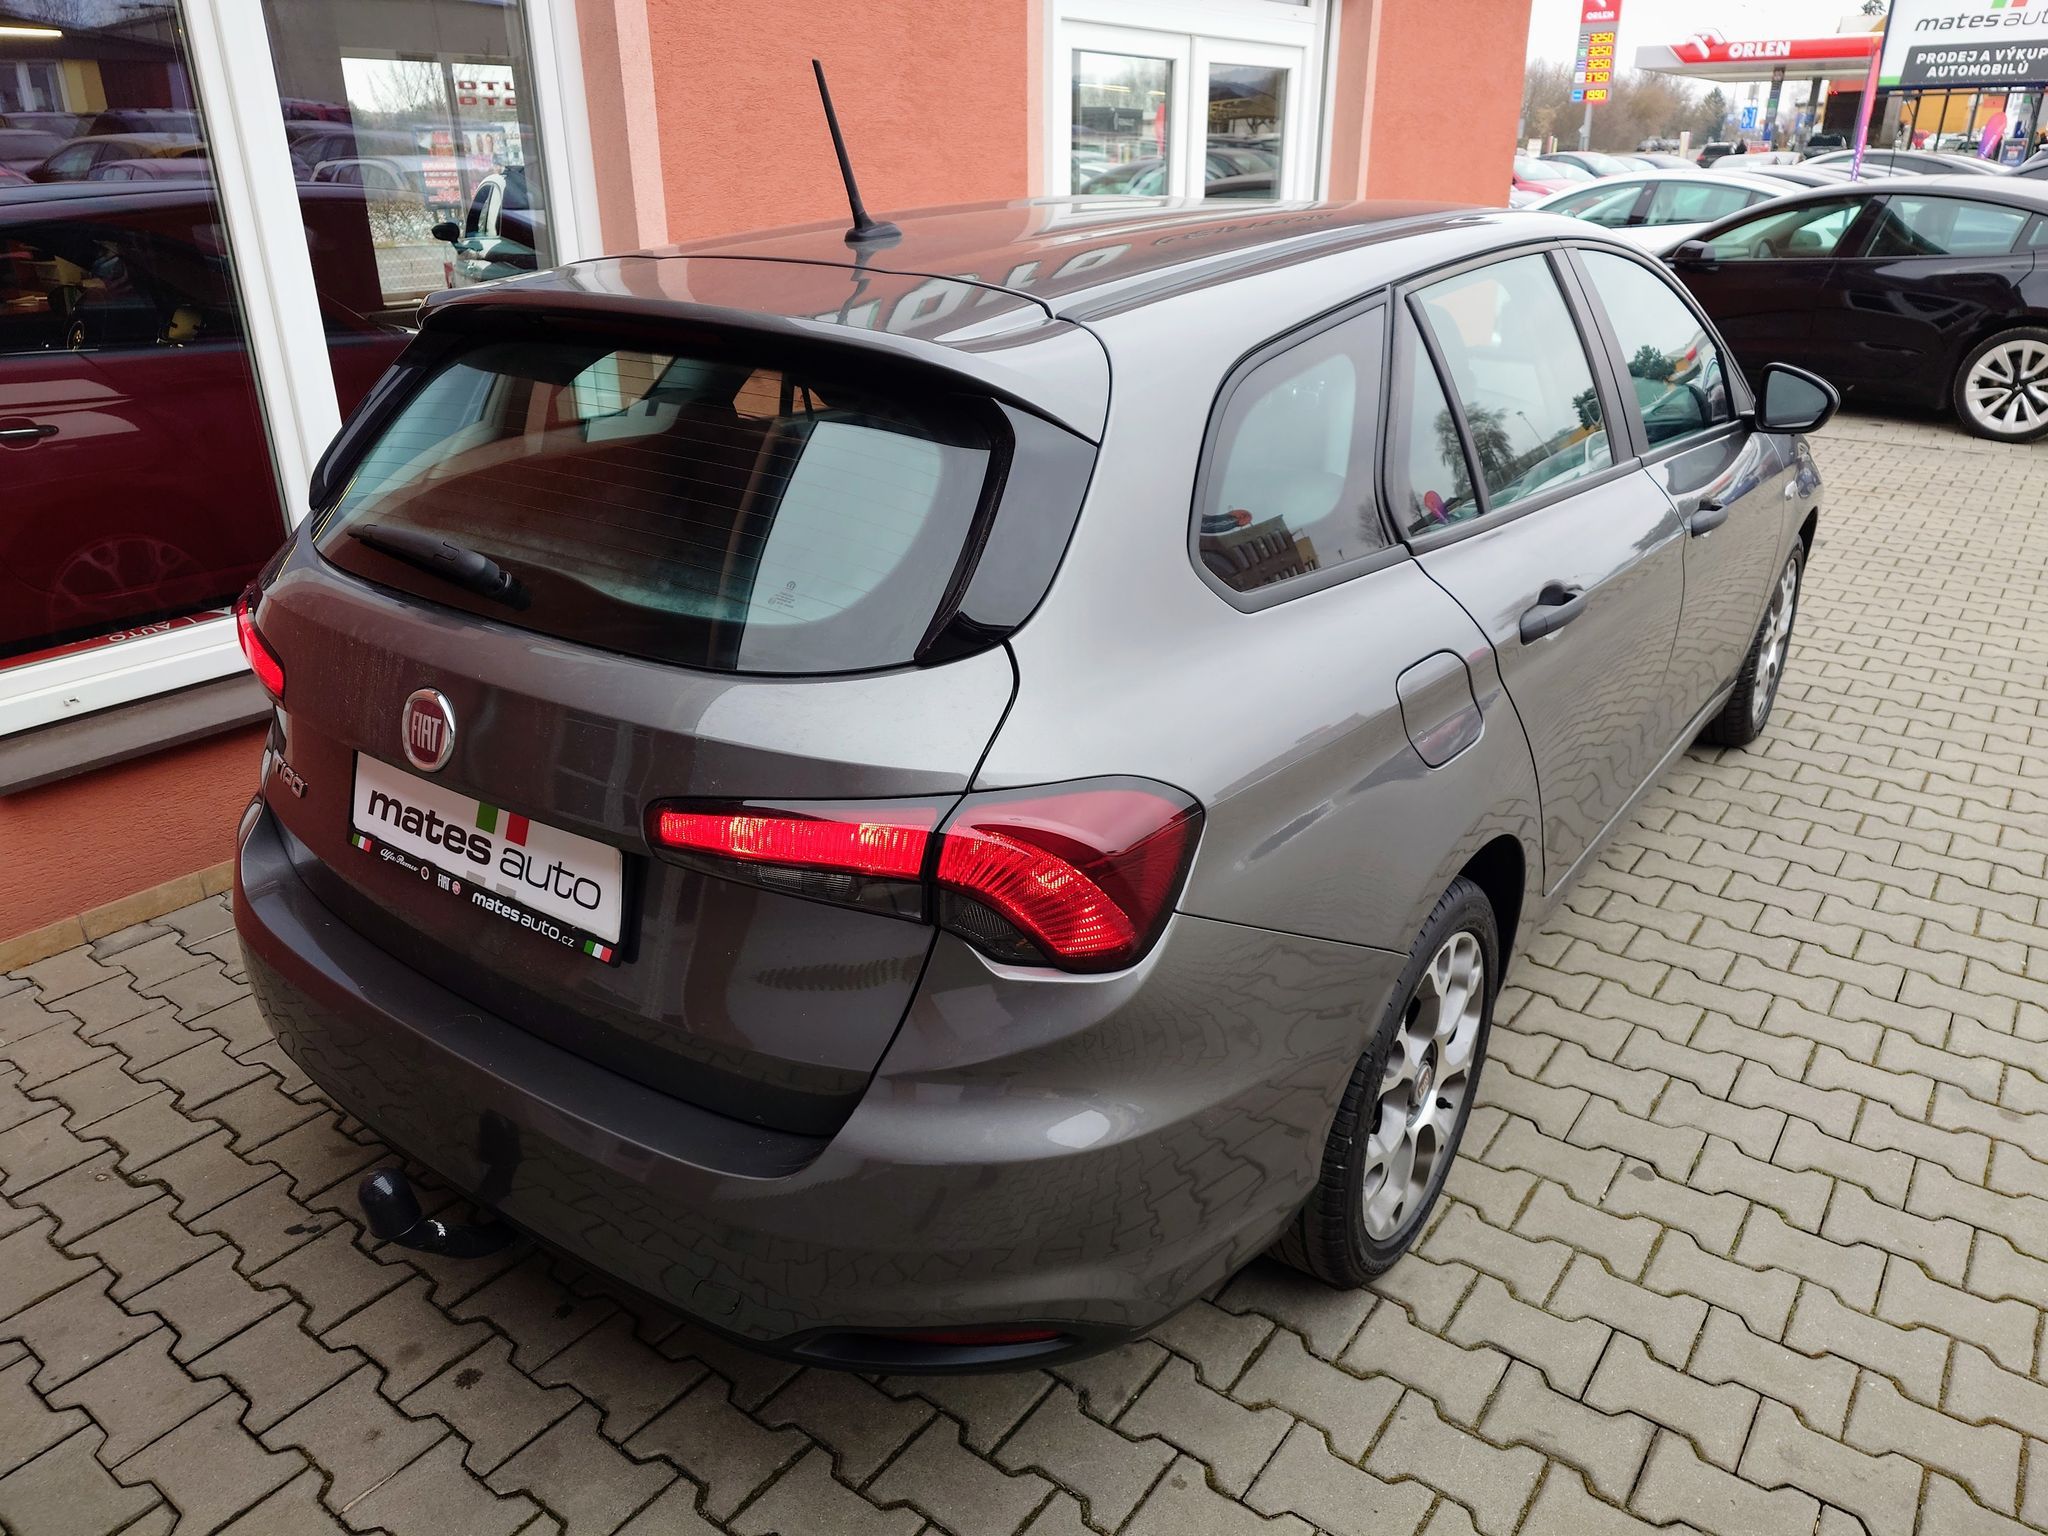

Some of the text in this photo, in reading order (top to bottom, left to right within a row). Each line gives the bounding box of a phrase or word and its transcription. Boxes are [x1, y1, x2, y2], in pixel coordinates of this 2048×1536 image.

[1914, 13, 2001, 31] mates
[1728, 41, 1791, 58] ORLEN
[1916, 46, 2048, 64] PRODEJ A VÝKUP
[1926, 60, 2029, 77] AUTOMOBILŮ
[411, 711, 442, 753] FIAT
[368, 789, 602, 910] mates auto
[471, 891, 575, 947] matesauto.cz
